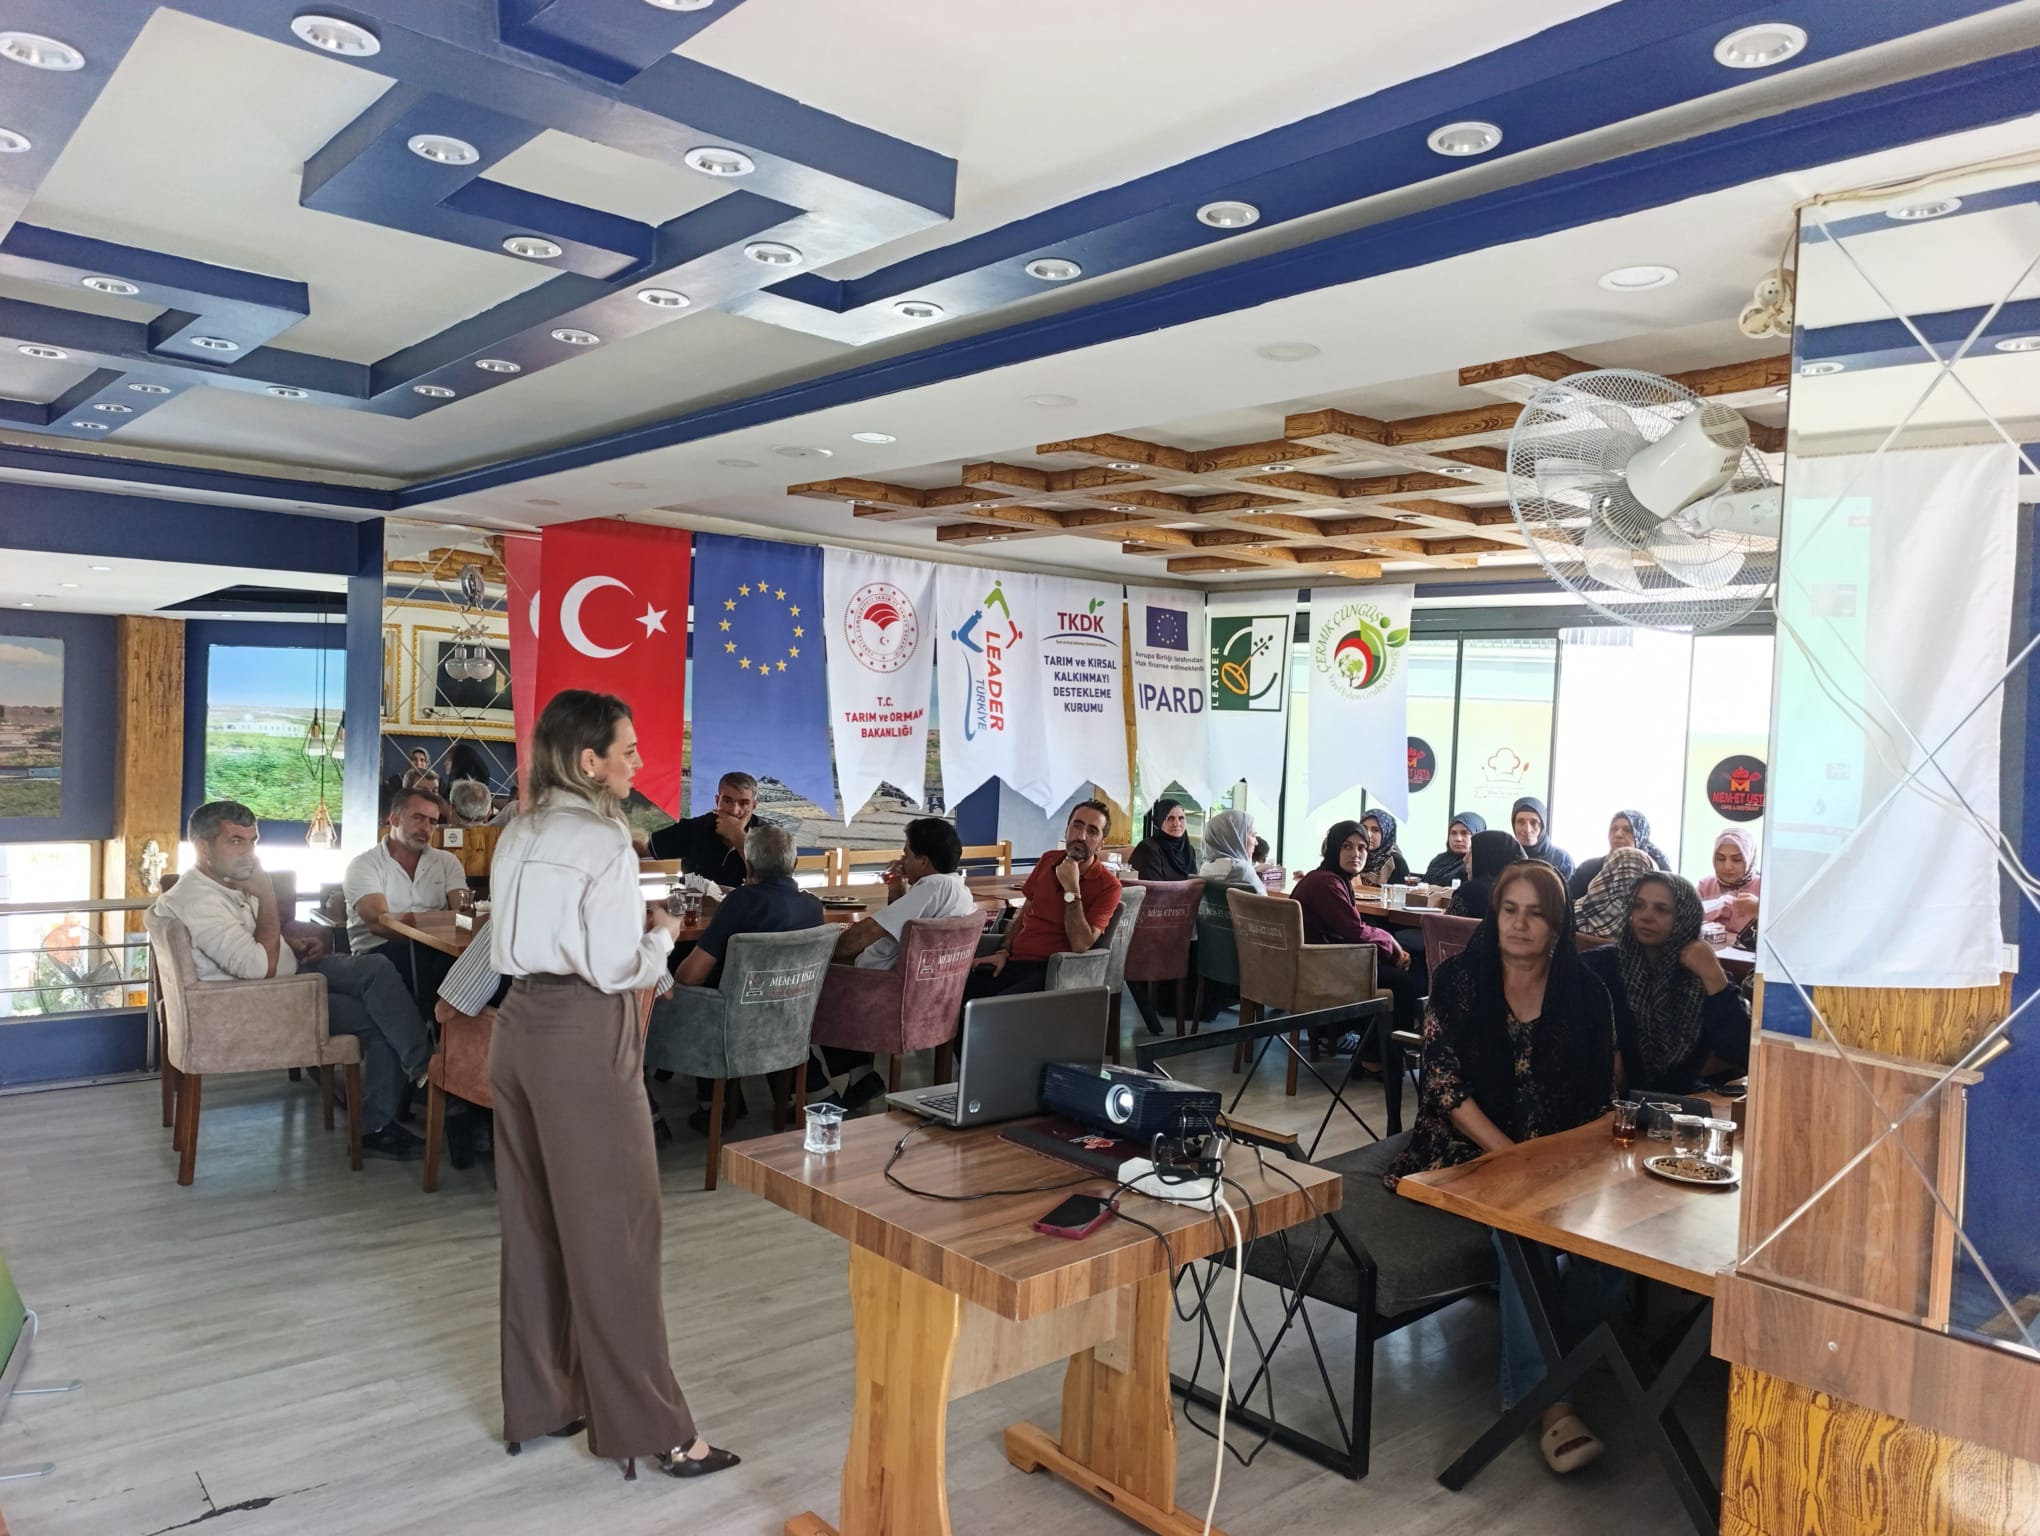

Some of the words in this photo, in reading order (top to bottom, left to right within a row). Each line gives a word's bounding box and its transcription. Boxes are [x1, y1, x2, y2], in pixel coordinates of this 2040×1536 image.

[1057, 612, 1104, 633] TKDK
[1044, 655, 1073, 667] TARIM
[1075, 659, 1086, 667] ve
[1088, 658, 1117, 670] KIRSAL
[986, 630, 1004, 731] LEADER
[1054, 671, 1110, 684] KALKINMAYI
[1211, 646, 1220, 707] LEADER
[1053, 686, 1112, 699] DESTEKLEME
[1138, 682, 1204, 714] IPARD
[877, 697, 893, 707] T.C.
[976, 679, 988, 731] TÜRKİYE
[1064, 702, 1103, 713] KURUMU
[845, 712, 877, 723] TARIM
[879, 714, 888, 722] ve
[890, 708, 924, 722] ORMAN
[861, 725, 913, 739] BAKANLIĞI
[1711, 791, 1745, 804] MEM-ET
